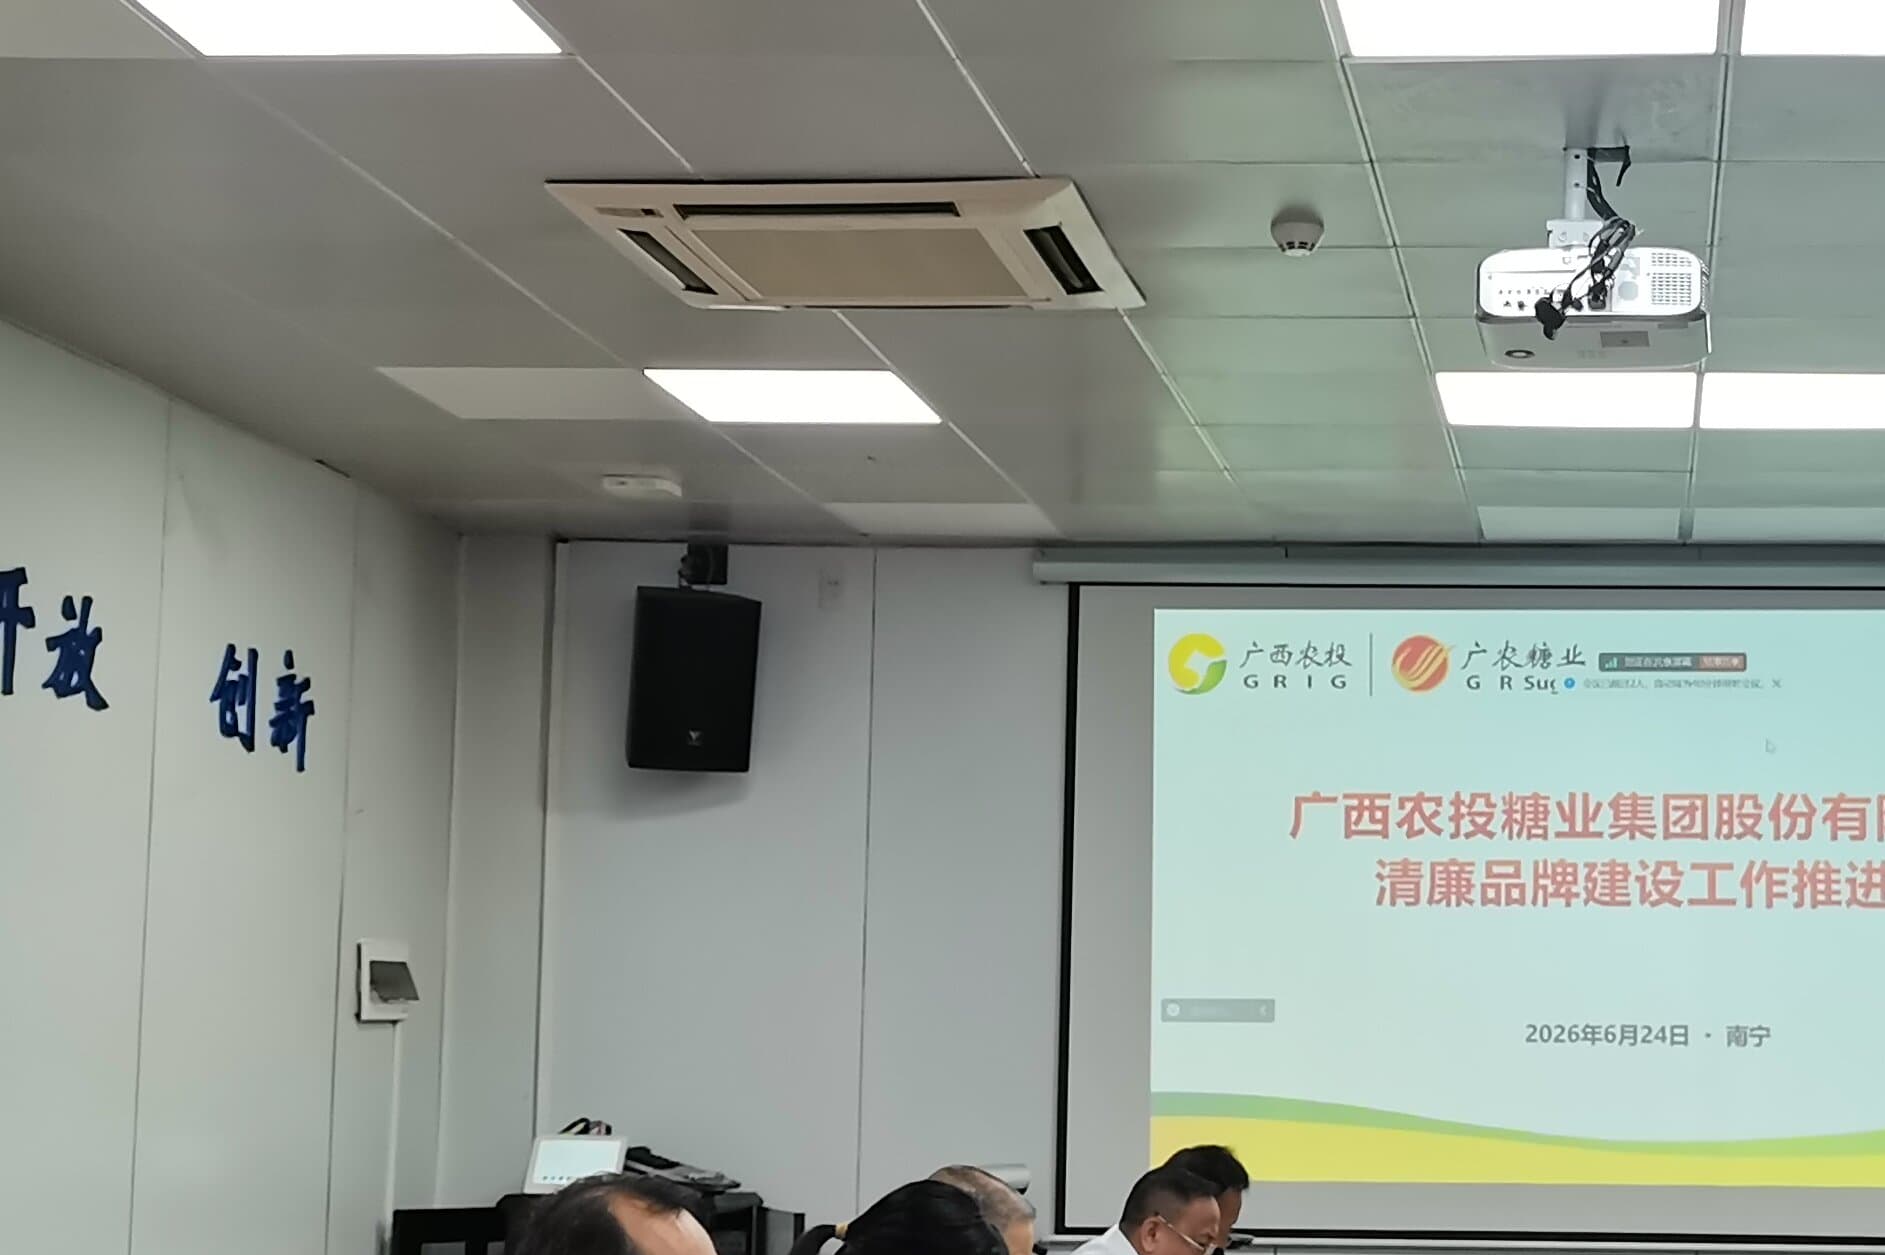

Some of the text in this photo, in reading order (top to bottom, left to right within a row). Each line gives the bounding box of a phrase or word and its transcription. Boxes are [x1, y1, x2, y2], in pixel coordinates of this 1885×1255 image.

[1239, 639, 1353, 669] 广西农投
[1461, 639, 1586, 671] 广农糖业
[209, 643, 315, 773] 创新
[1525, 1023, 1689, 1047] 2026年6月24日
[1726, 1024, 1772, 1048] 南宁
